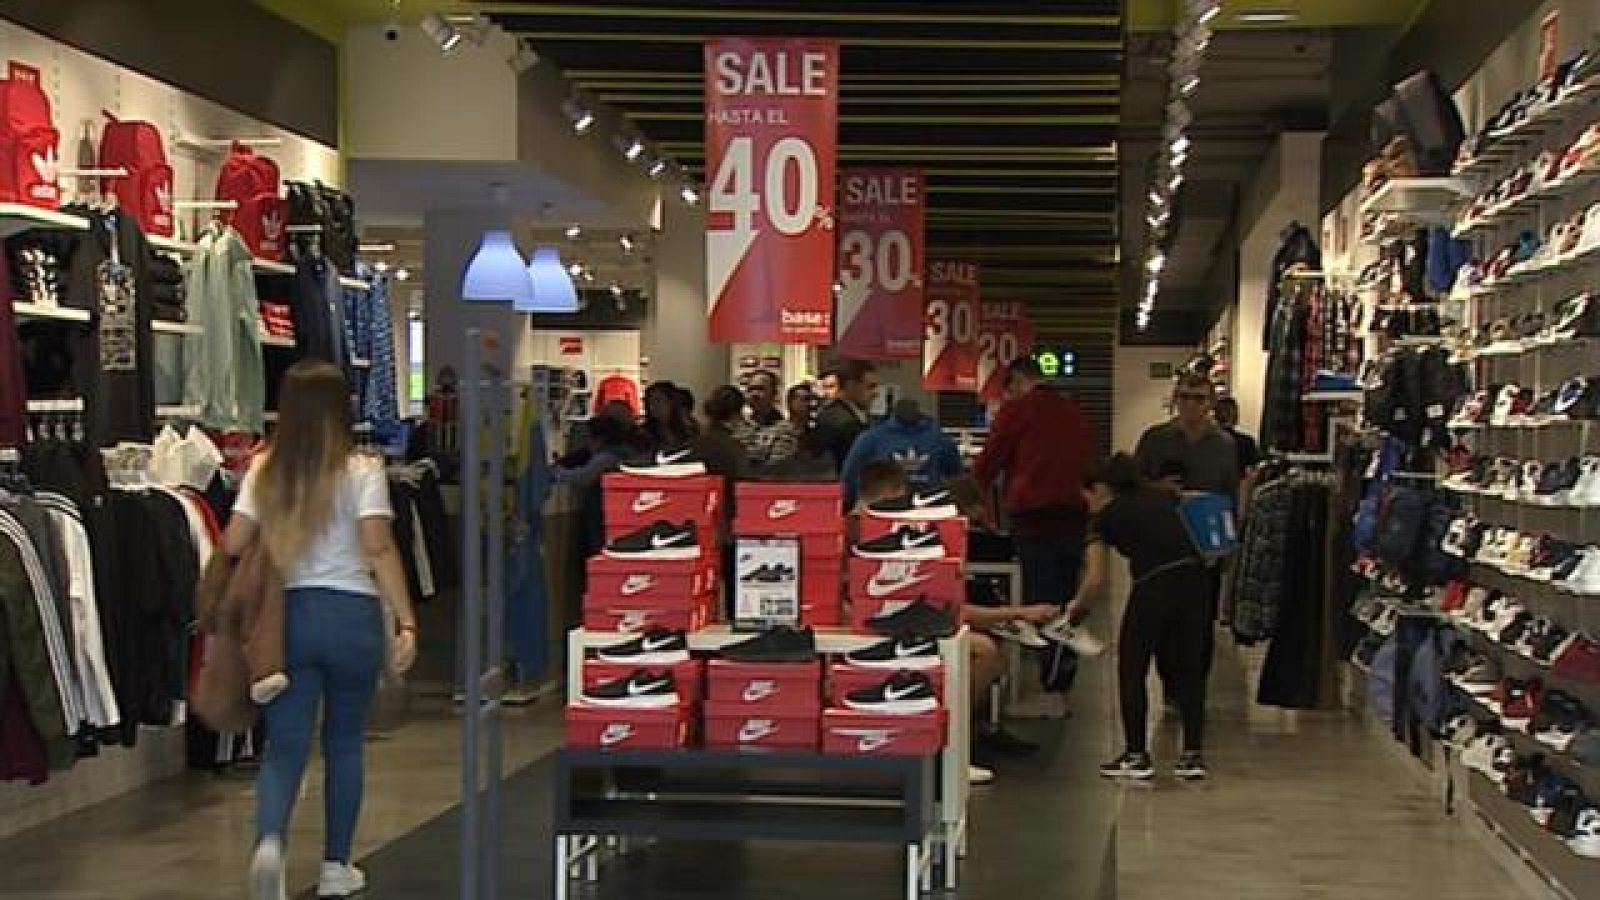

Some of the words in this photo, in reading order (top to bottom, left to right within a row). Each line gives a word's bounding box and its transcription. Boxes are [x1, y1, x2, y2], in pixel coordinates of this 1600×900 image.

[716, 51, 826, 95] SALE
[707, 109, 762, 125] HASTA
[766, 109, 790, 125] EL
[845, 176, 917, 203] SALE
